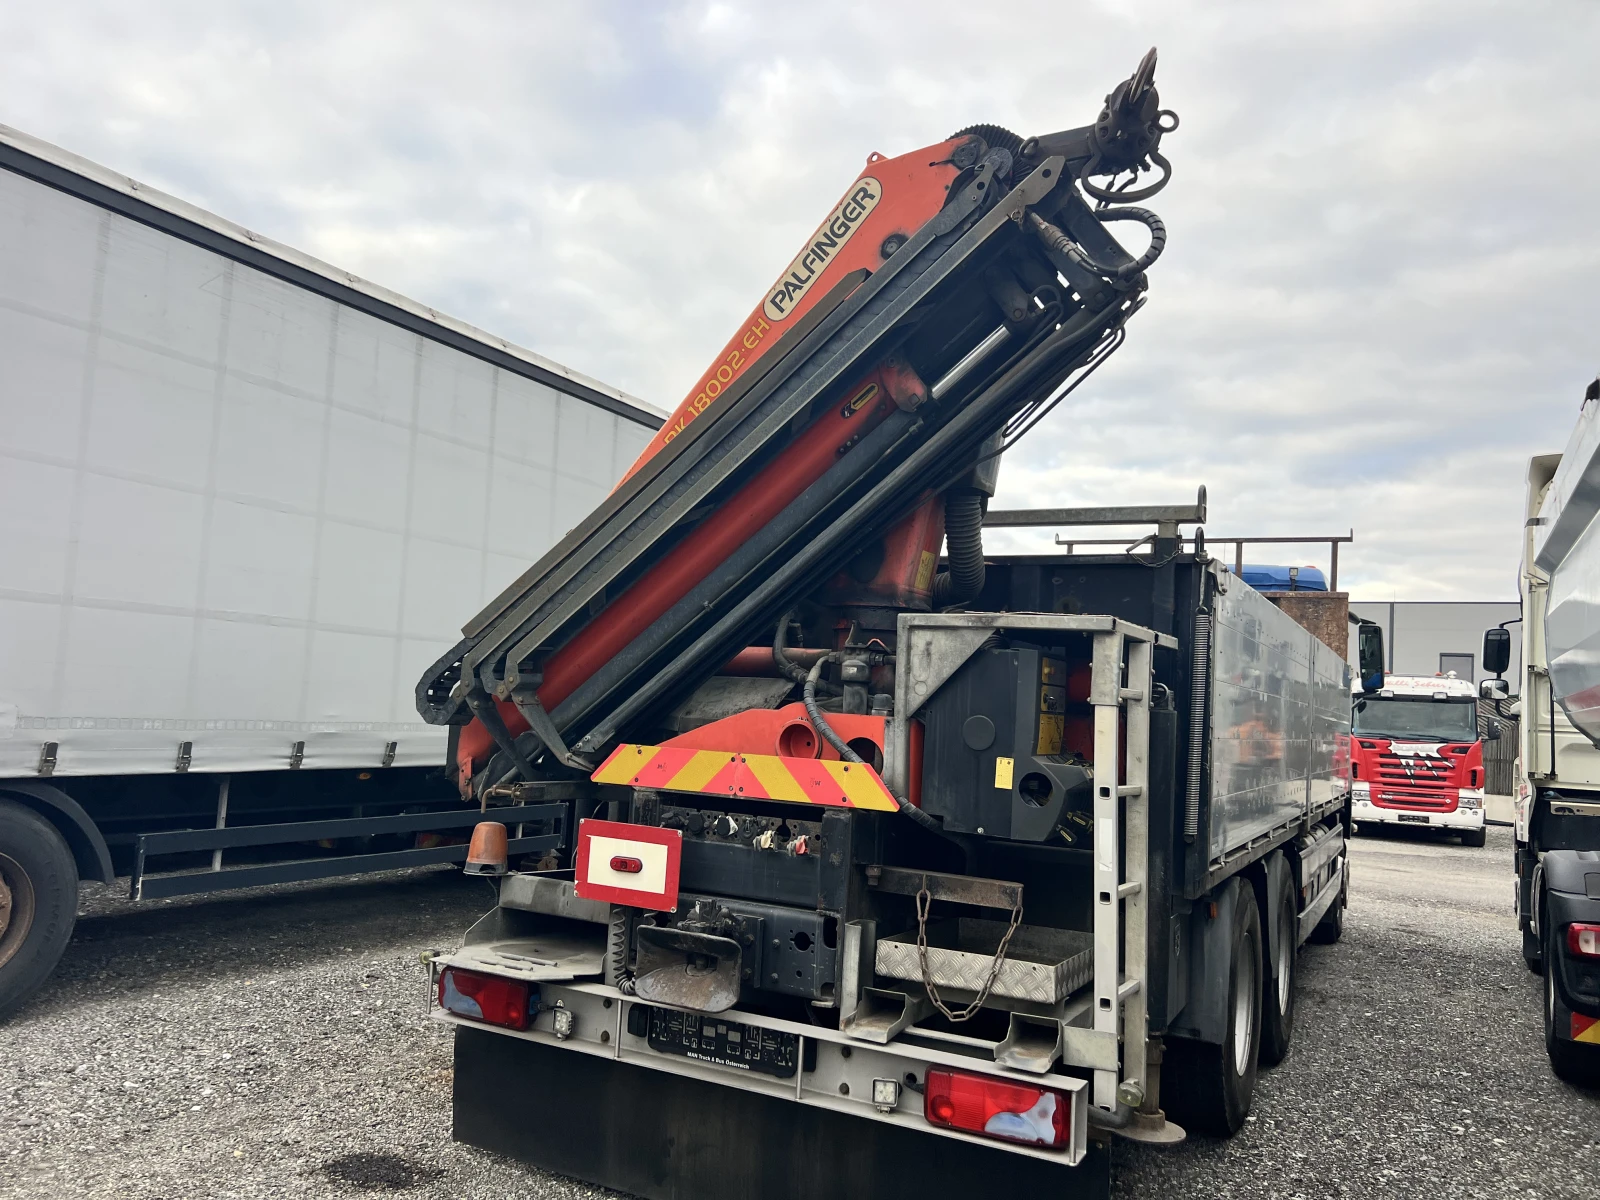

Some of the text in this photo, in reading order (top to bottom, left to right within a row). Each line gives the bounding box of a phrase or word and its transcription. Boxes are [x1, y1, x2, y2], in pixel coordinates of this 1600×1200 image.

[770, 186, 886, 313] PALFINGER
[698, 1054, 711, 1062] Truck
[716, 1057, 725, 1065] Bus
